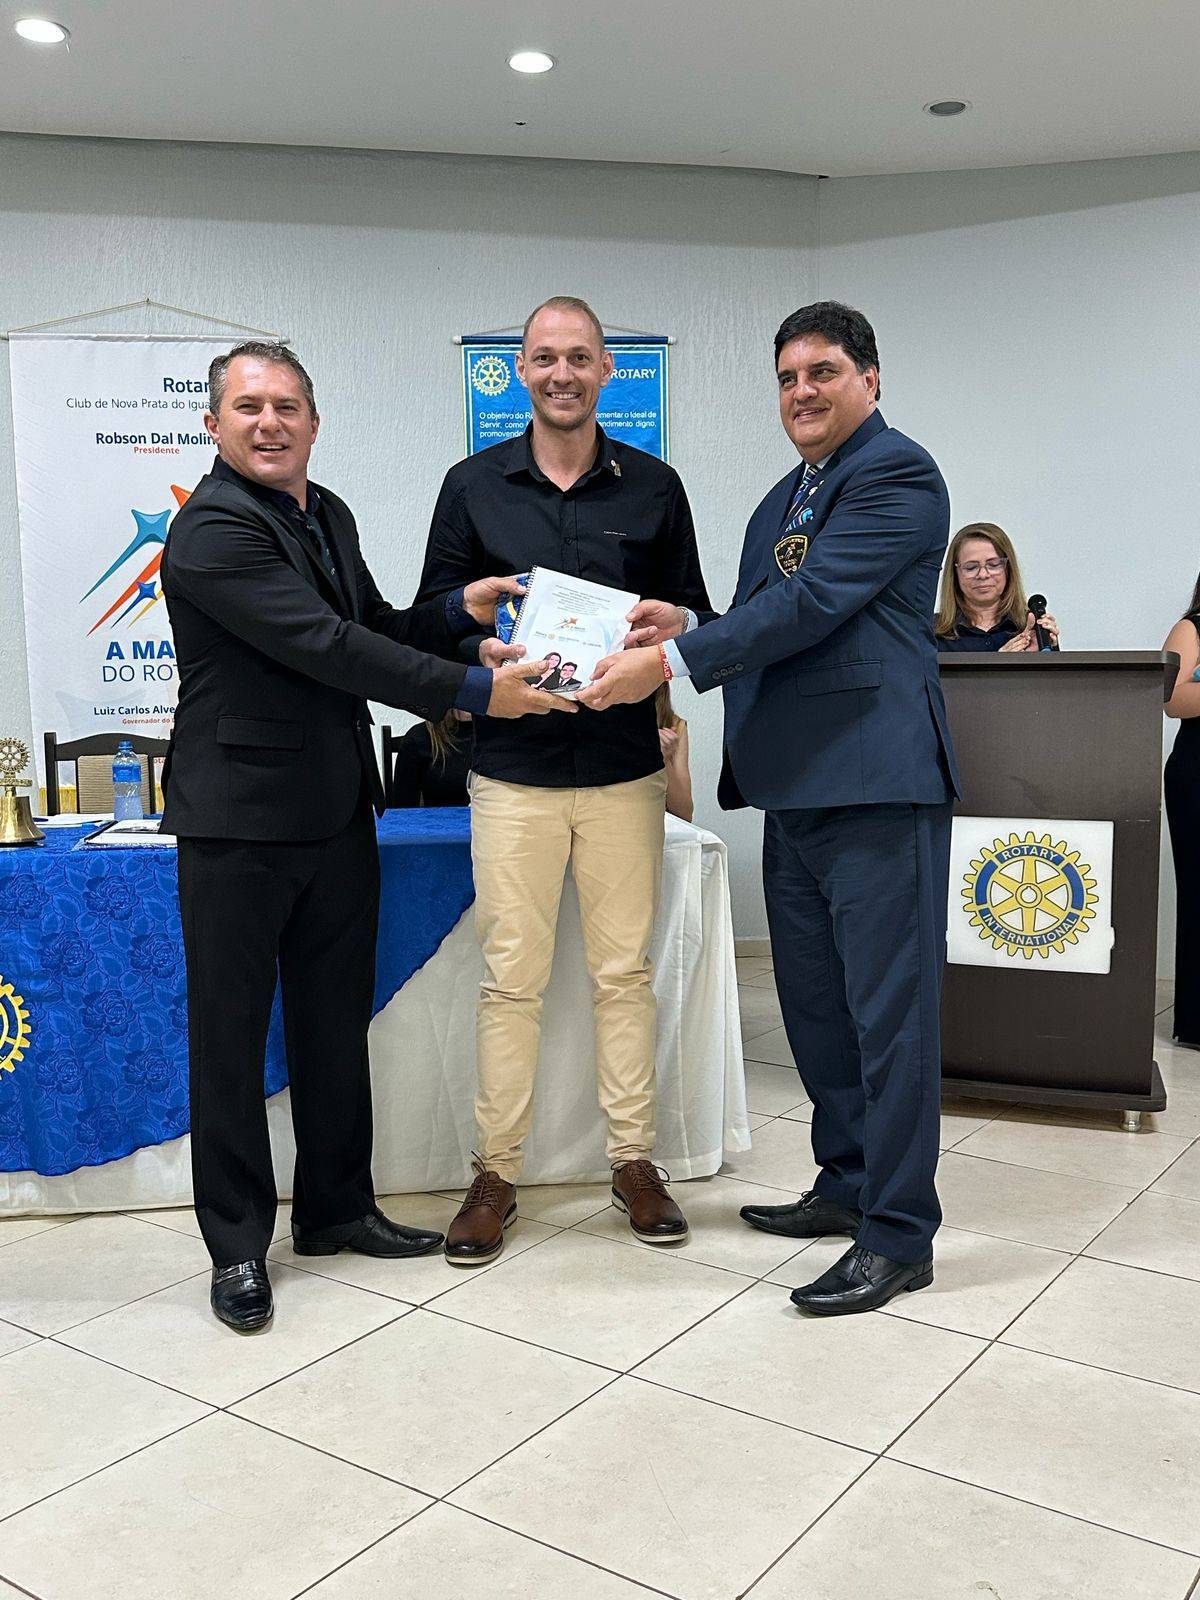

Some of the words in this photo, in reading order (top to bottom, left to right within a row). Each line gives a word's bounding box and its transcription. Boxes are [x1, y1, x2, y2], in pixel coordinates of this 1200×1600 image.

[610, 368, 657, 379] ROTARY
[163, 377, 210, 393] Rotar
[66, 398, 92, 409] Club
[94, 398, 108, 409] de
[112, 399, 138, 409] Nova
[141, 399, 168, 409] Prata
[171, 399, 185, 409] do
[188, 399, 211, 411] Igua
[479, 411, 486, 419] O
[487, 411, 514, 420] objetivo
[514, 411, 524, 419] do
[595, 411, 623, 419] omentar
[647, 411, 657, 419] de
[96, 432, 147, 444] Robson
[151, 432, 173, 445] Dal
[177, 433, 215, 445] Molin
[133, 446, 180, 454] Presidente
[106, 641, 125, 660] A
[132, 640, 176, 660] MA
[102, 665, 135, 682] DO
[143, 664, 177, 681] RO
[93, 706, 115, 716] Luiz
[118, 705, 150, 715] Carlos
[152, 704, 176, 714] Alve
[122, 717, 160, 725] Governador
[1002, 846, 1059, 861] ROTARY
[982, 912, 1077, 947] INTERNATIONAL
